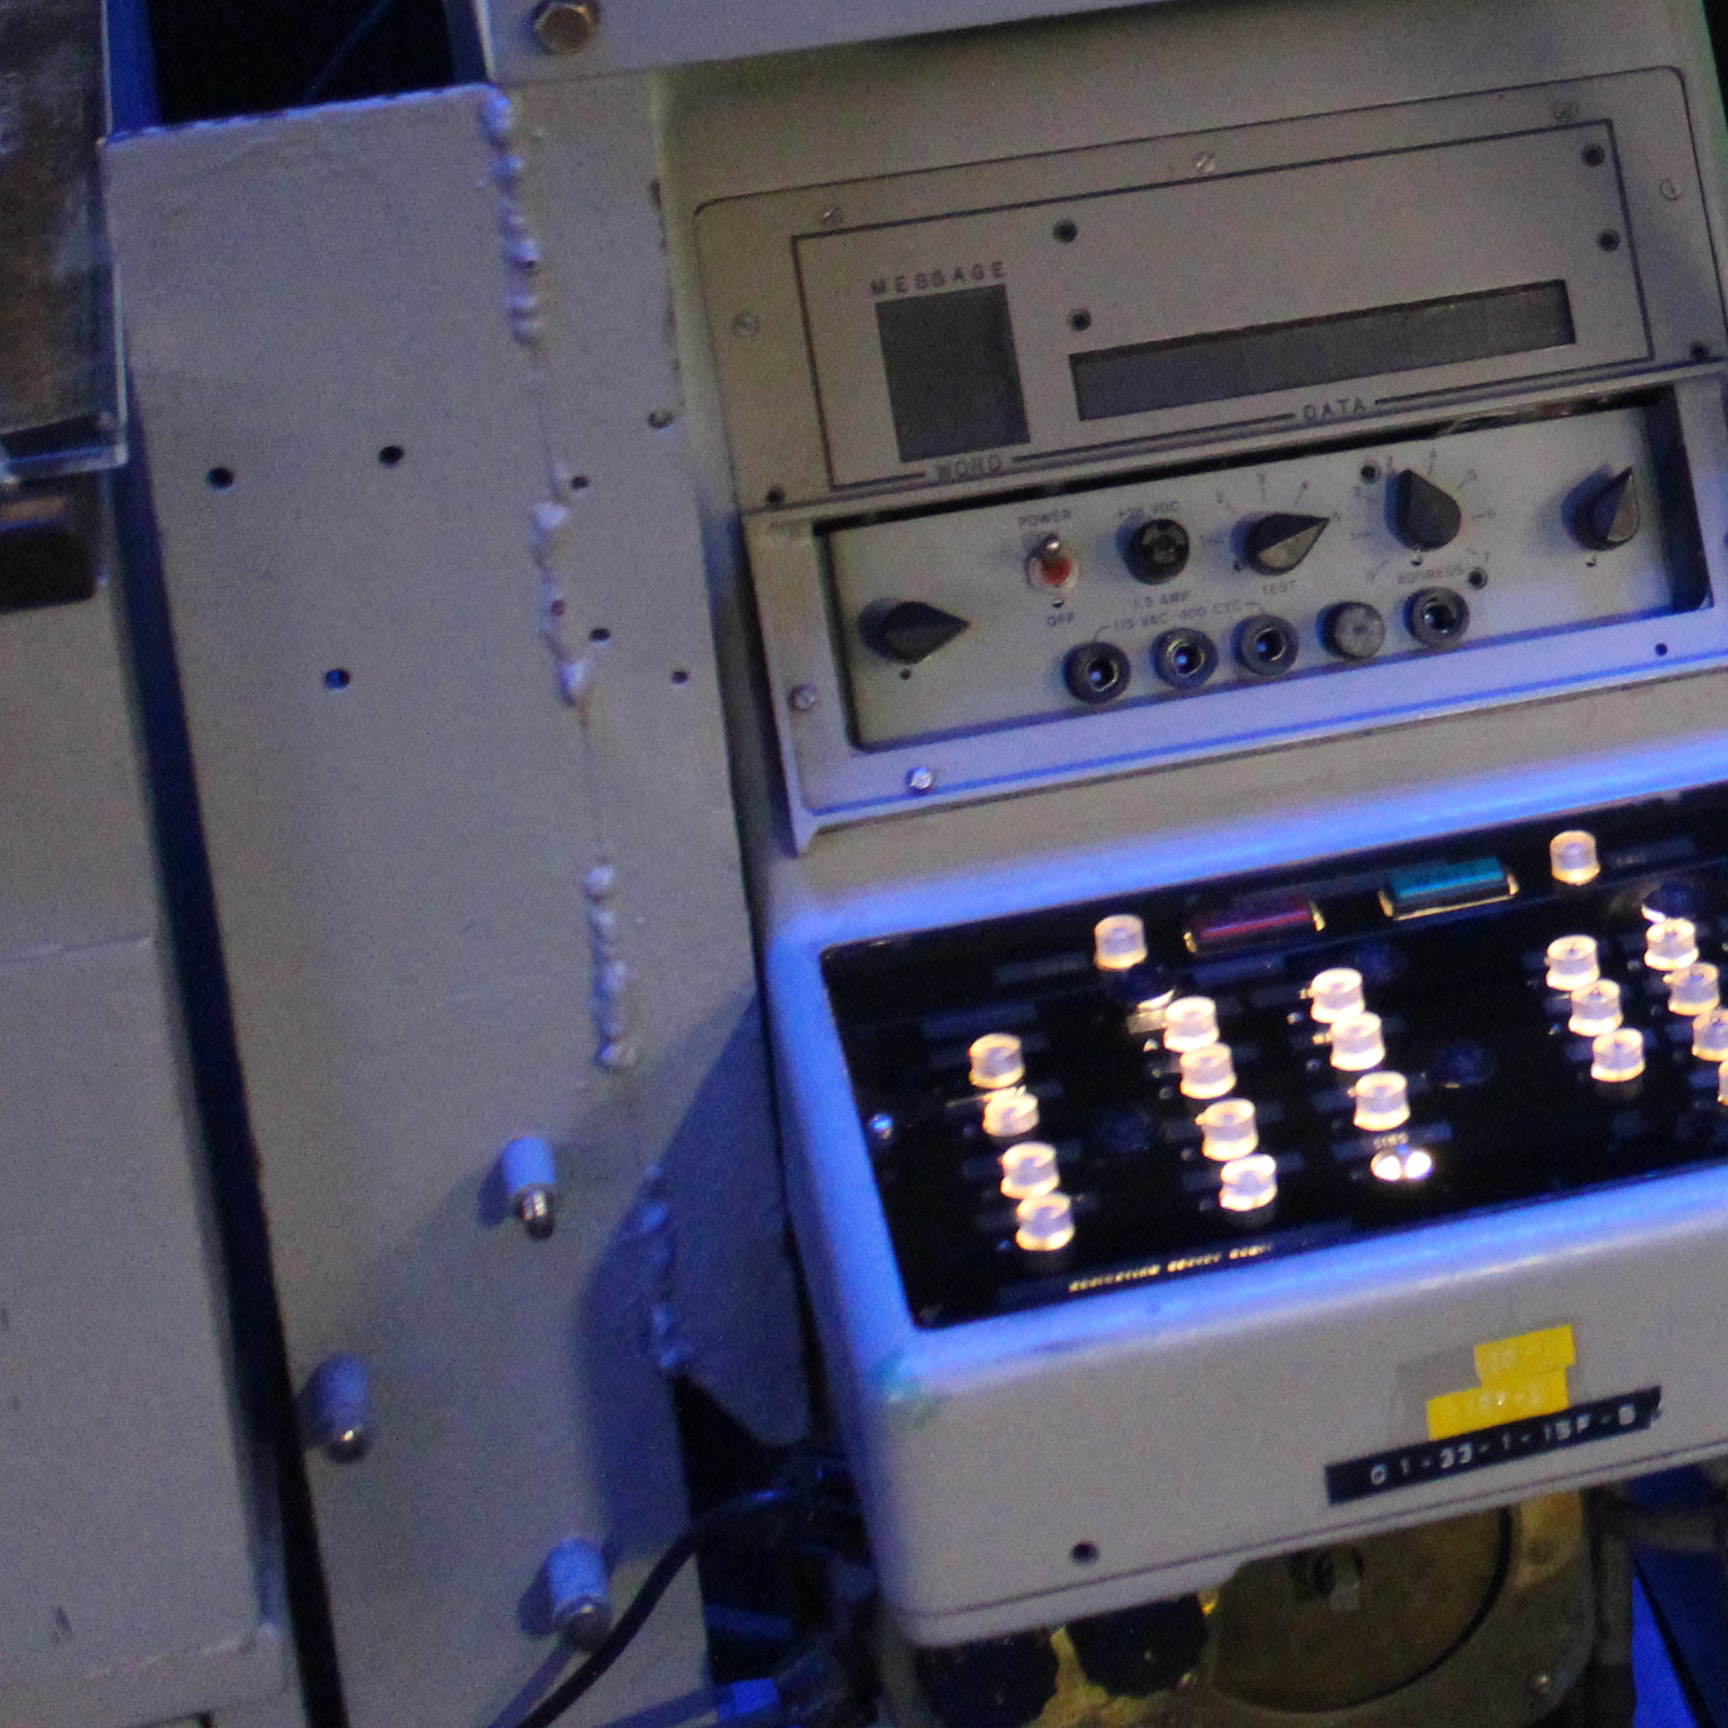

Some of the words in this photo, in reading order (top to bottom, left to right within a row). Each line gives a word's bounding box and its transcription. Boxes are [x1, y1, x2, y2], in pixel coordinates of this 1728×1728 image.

[870, 261, 1006, 297] MESSAGE
[1302, 396, 1366, 423] DATA
[936, 454, 1002, 480] WORD
[1018, 509, 1072, 529] POWER
